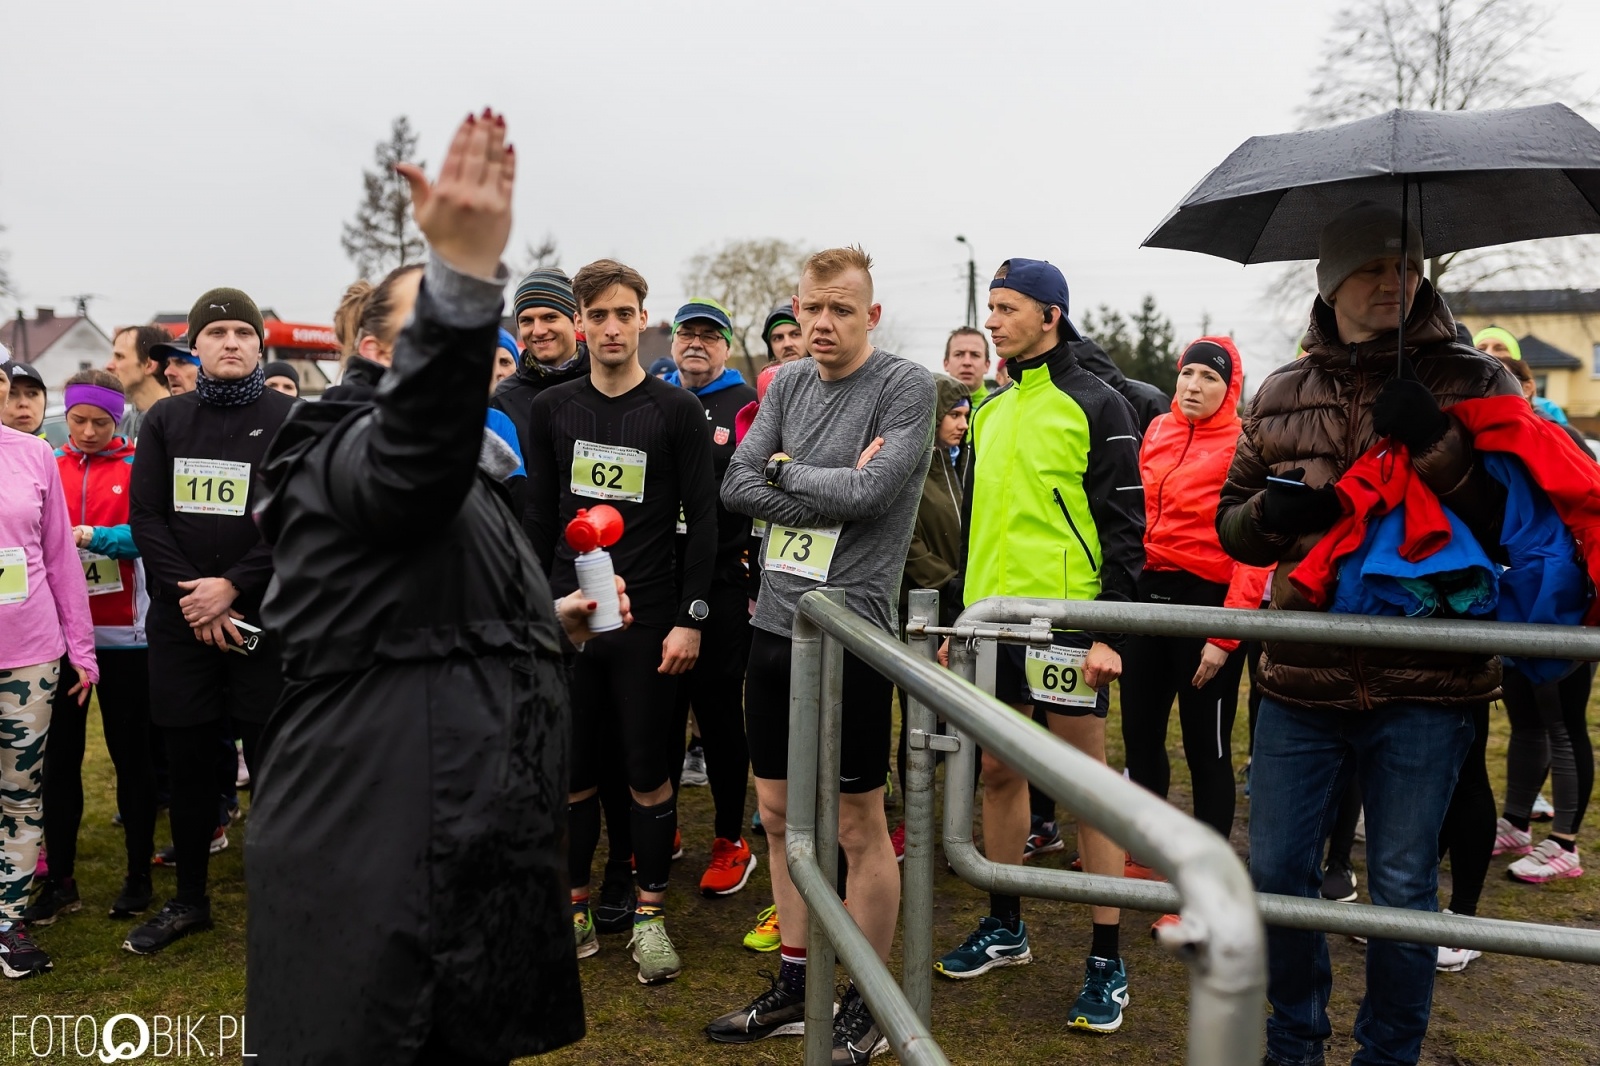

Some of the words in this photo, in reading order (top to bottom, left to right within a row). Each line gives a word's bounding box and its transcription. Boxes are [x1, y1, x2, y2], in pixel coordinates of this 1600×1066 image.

[187, 477, 235, 503] 116
[591, 462, 623, 490] 62
[780, 530, 813, 562] 73
[1042, 664, 1078, 693] 69
